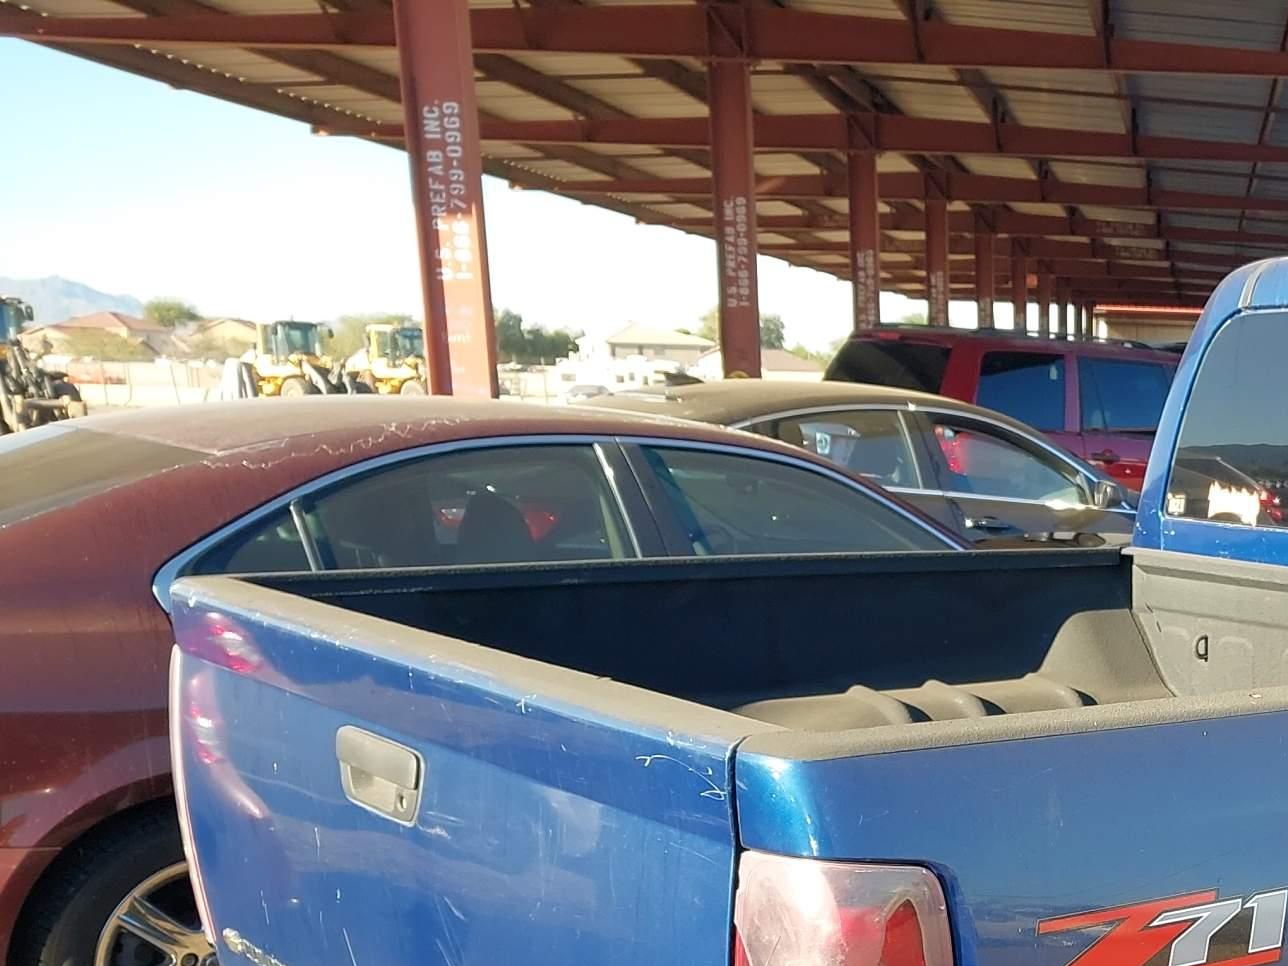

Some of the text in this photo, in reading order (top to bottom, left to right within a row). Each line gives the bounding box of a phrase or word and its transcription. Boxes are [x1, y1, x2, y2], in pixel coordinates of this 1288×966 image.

[422, 99, 442, 139] INC.
[426, 150, 450, 231] PREFAB
[724, 226, 737, 277] PREFAB
